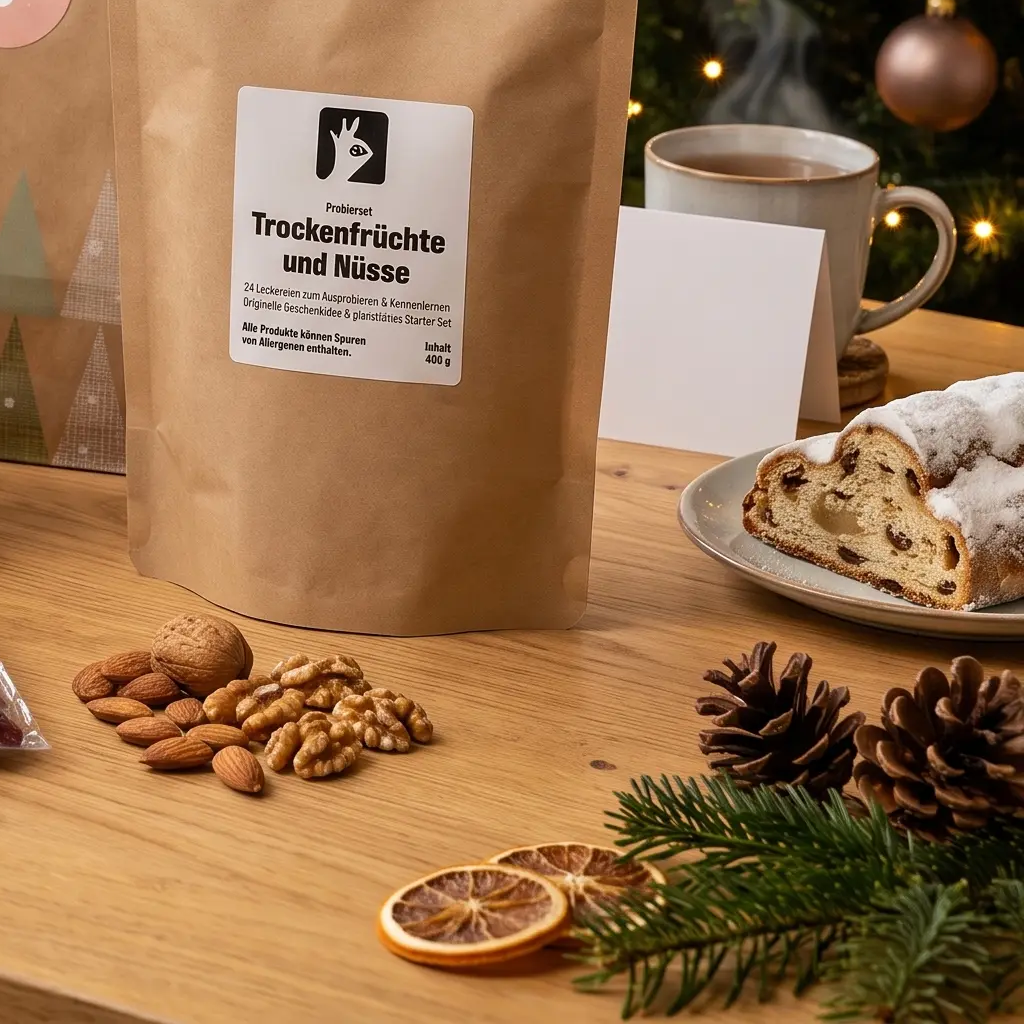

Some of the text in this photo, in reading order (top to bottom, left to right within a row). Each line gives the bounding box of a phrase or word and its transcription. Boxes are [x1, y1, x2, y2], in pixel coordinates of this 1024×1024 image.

[325, 202, 373, 217] Probierset
[251, 211, 446, 254] Trockenfrüchte
[283, 252, 410, 284] und Nüsse
[244, 281, 450, 313] 24 Leckereien zum Ausprobieren & Kennenlernen
[243, 296, 282, 311] Originelle
[284, 302, 342, 318] Geschenkidee
[344, 309, 350, 319] &
[405, 314, 436, 327] Starter
[437, 317, 452, 328] Set
[242, 321, 258, 333] Alle
[260, 324, 298, 338] Produkte
[334, 332, 366, 346] Spuren
[242, 336, 257, 346] von
[306, 344, 352, 357] enthalten.
[424, 341, 452, 353] Inhalt
[425, 354, 451, 368] 400 g
